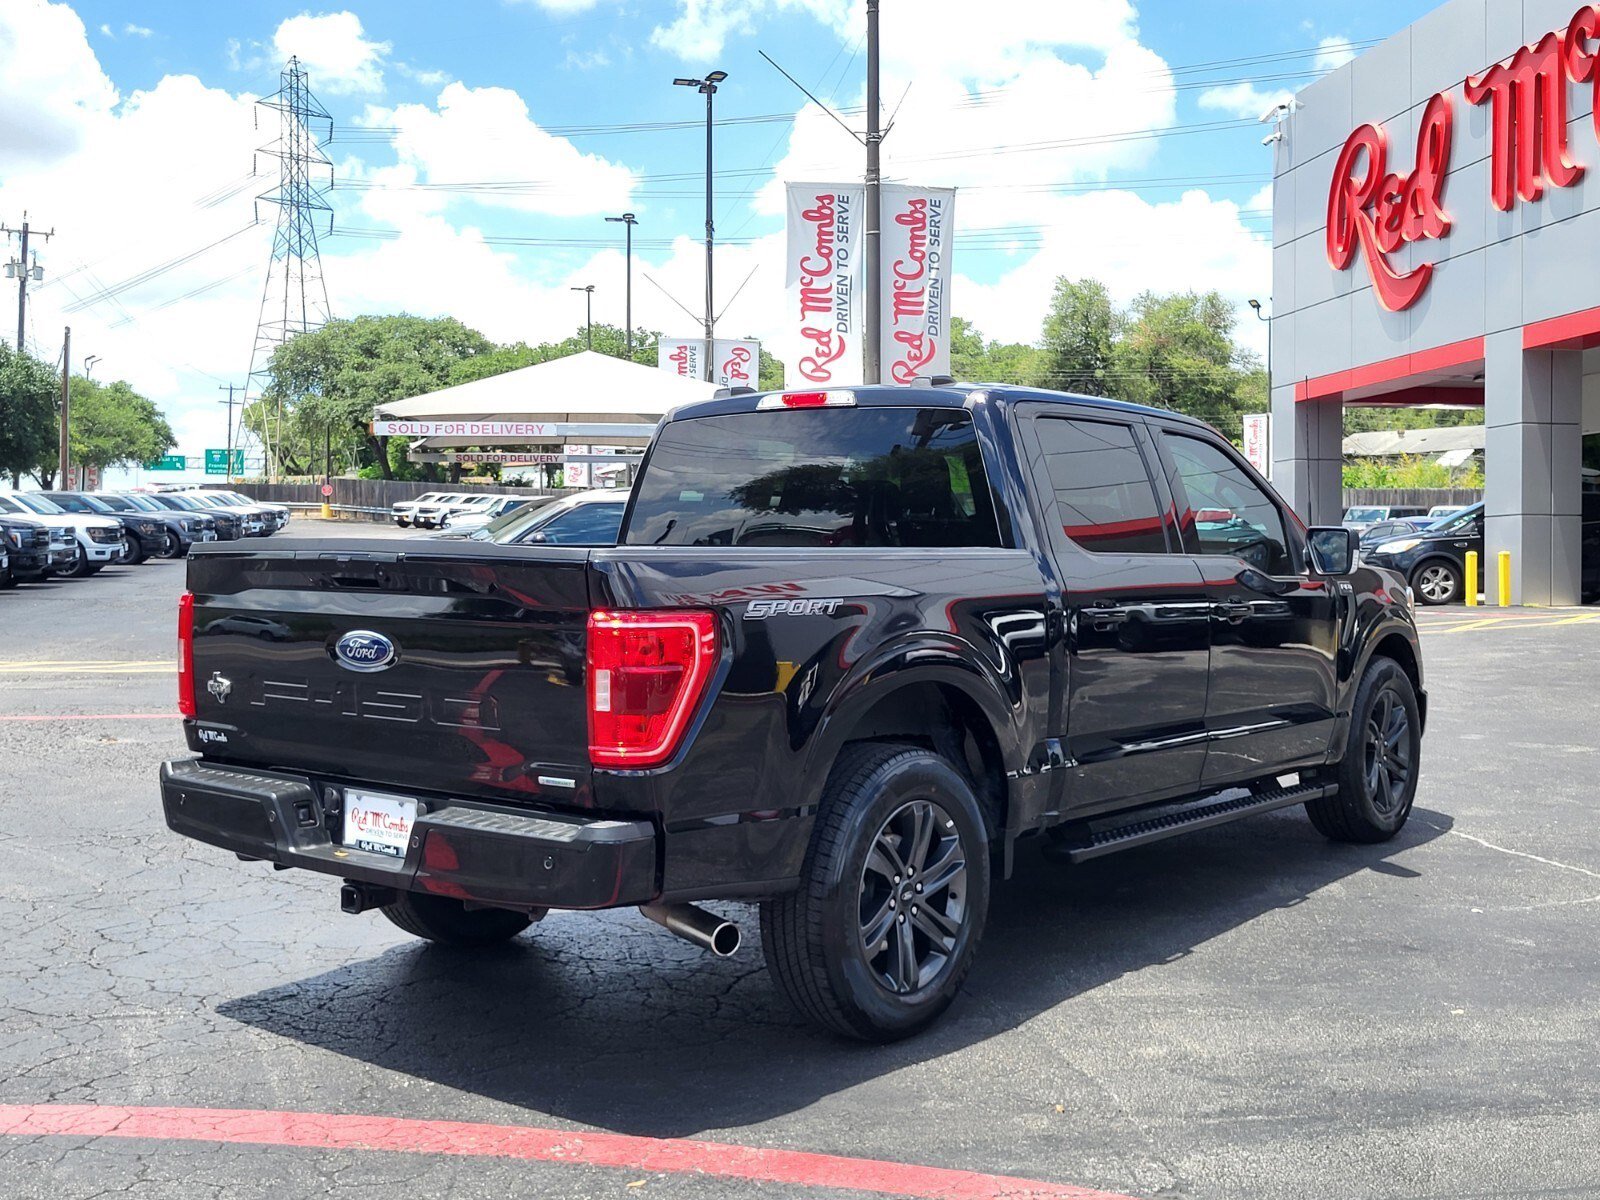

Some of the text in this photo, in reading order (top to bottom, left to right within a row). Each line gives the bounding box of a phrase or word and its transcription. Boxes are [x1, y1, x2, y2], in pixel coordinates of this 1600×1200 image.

[1326, 93, 1453, 312] Red
[836, 194, 850, 334] DRIVEN TO SERVE
[928, 199, 941, 337] DRIVEN TO SERVE
[799, 194, 846, 383] Red McCombs
[892, 198, 936, 385] Red McCombs
[689, 345, 697, 374] SERVE
[723, 347, 751, 380] Red
[387, 423, 545, 435] SOLD FOR DELIVERY
[455, 454, 560, 463] SOLD FOR DELIVERY
[743, 599, 844, 620] SPORT
[346, 638, 378, 660] Ford
[351, 807, 408, 833] Red McCombs
[393, 832, 408, 840] SERVE
